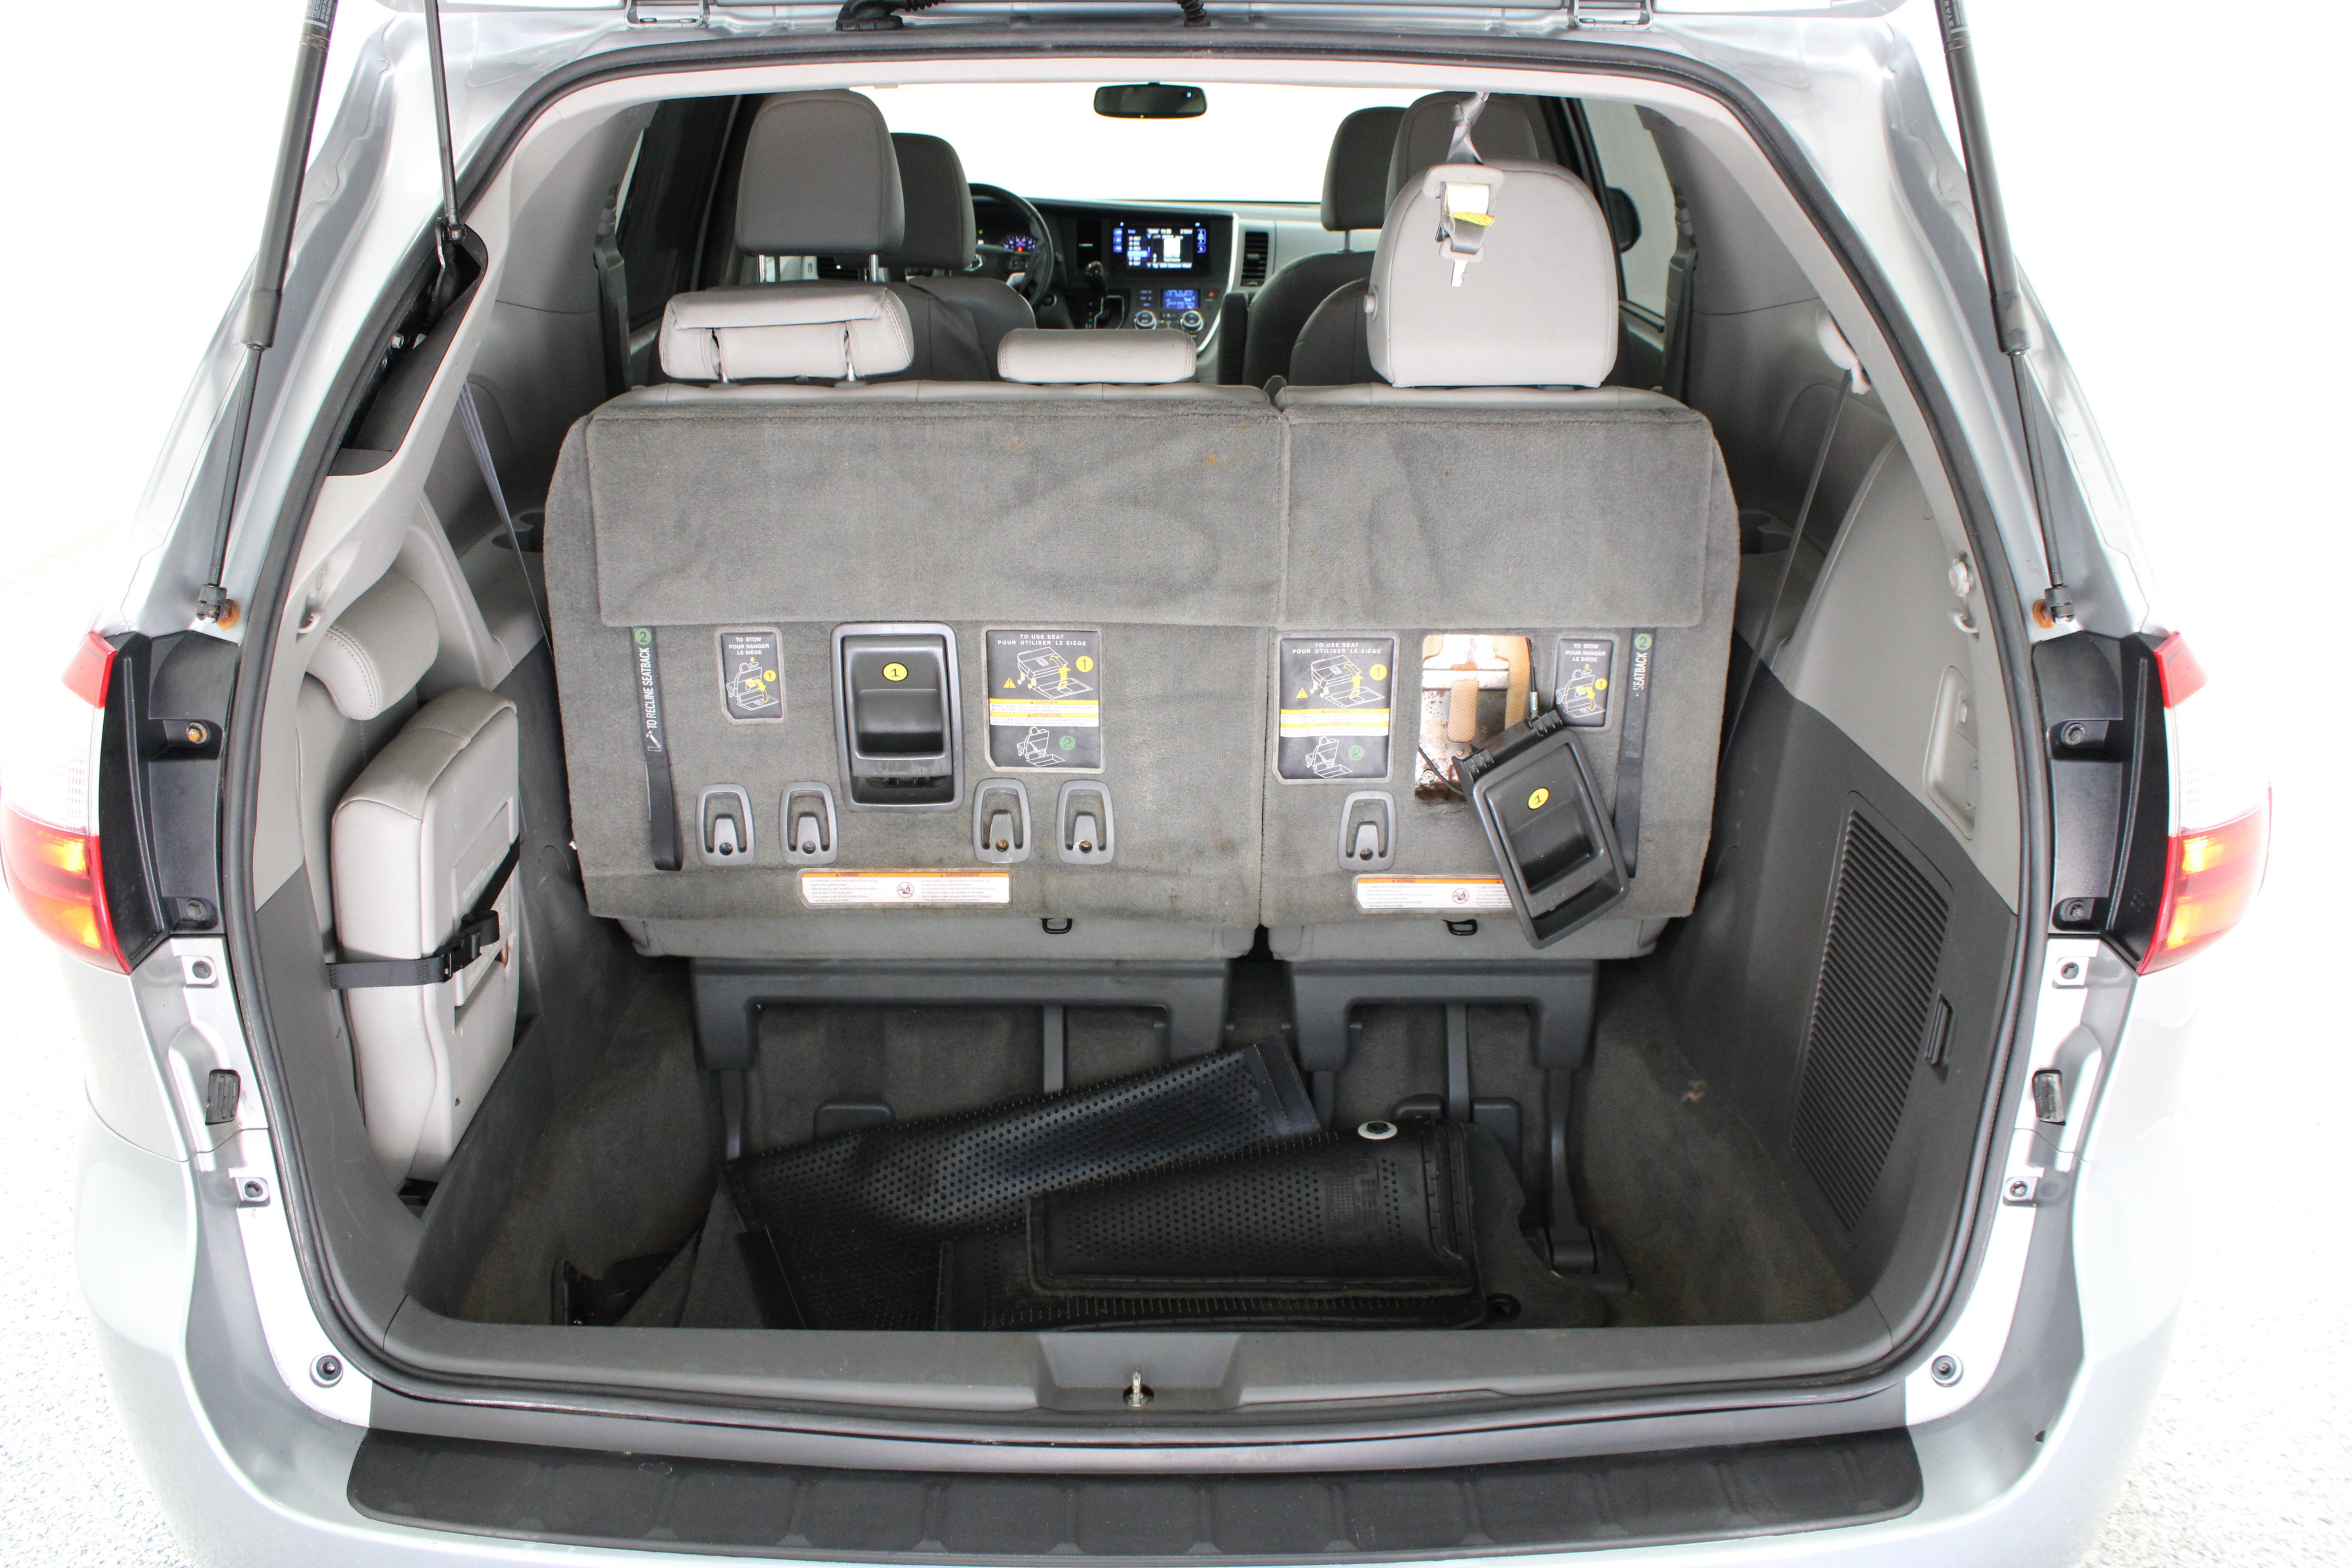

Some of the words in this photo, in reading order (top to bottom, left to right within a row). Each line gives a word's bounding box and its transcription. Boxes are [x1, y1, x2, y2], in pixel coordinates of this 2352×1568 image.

[639, 631, 647, 642] 2
[1639, 636, 1646, 648] 2
[639, 647, 653, 686] SEATBACK
[1081, 659, 1087, 669] 1
[891, 668, 900, 677] 1
[1376, 667, 1380, 677] 1
[1633, 652, 1648, 690] SEATBACK
[643, 687, 656, 718] RECLINE
[647, 719, 657, 729] TO
[1063, 738, 1071, 748] 2
[1352, 748, 1360, 758] 2
[1535, 795, 1543, 805] 1
